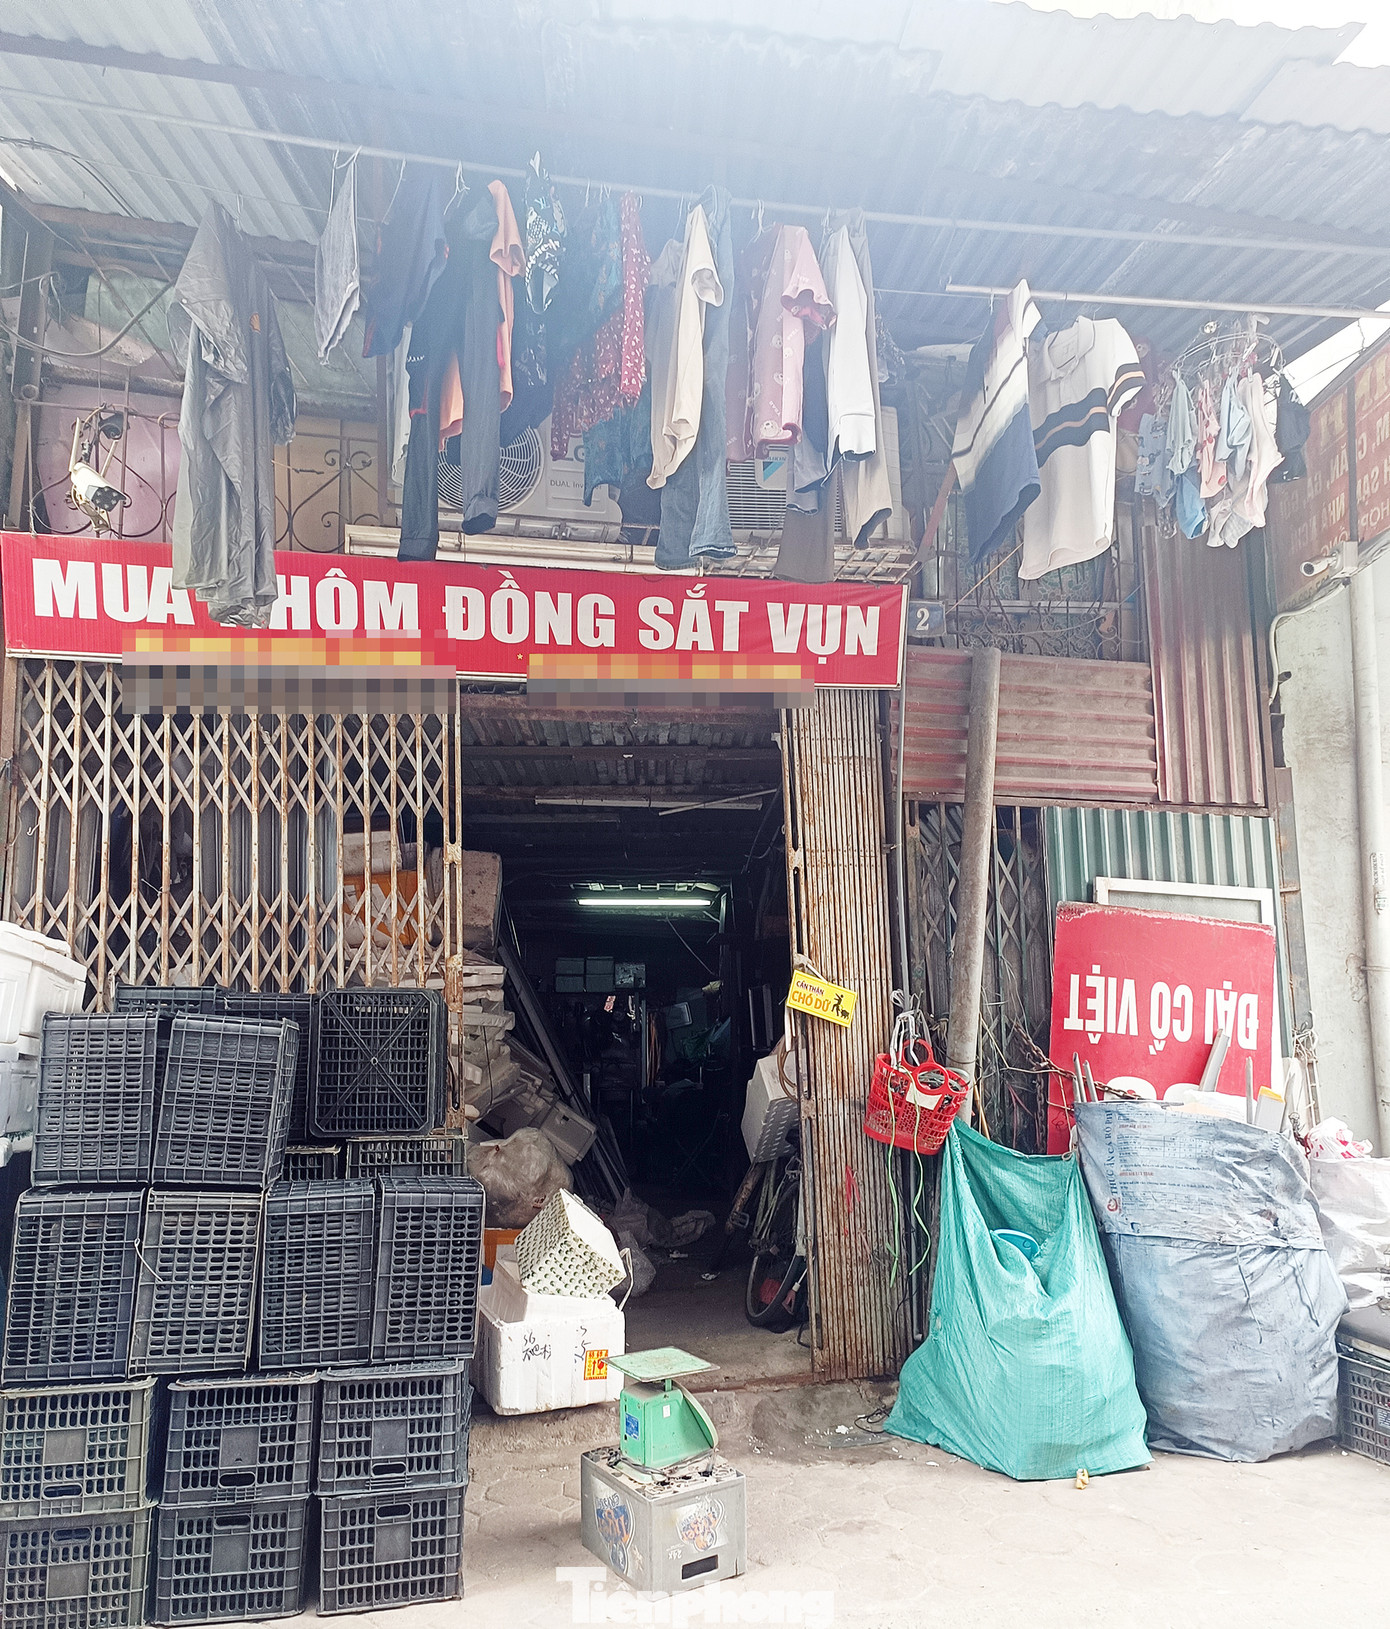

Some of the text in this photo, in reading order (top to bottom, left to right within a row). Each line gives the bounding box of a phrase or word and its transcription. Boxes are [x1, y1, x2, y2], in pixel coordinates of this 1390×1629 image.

[550, 480, 570, 488] DUAL
[32, 558, 880, 665] MUA HÔM ĐỒNG SẮT VỤN
[916, 607, 930, 631] 2
[792, 990, 832, 1012] CHÓ DỮ
[1063, 964, 1139, 1044] VIỆT
[1204, 980, 1259, 1051] ĐẠI
